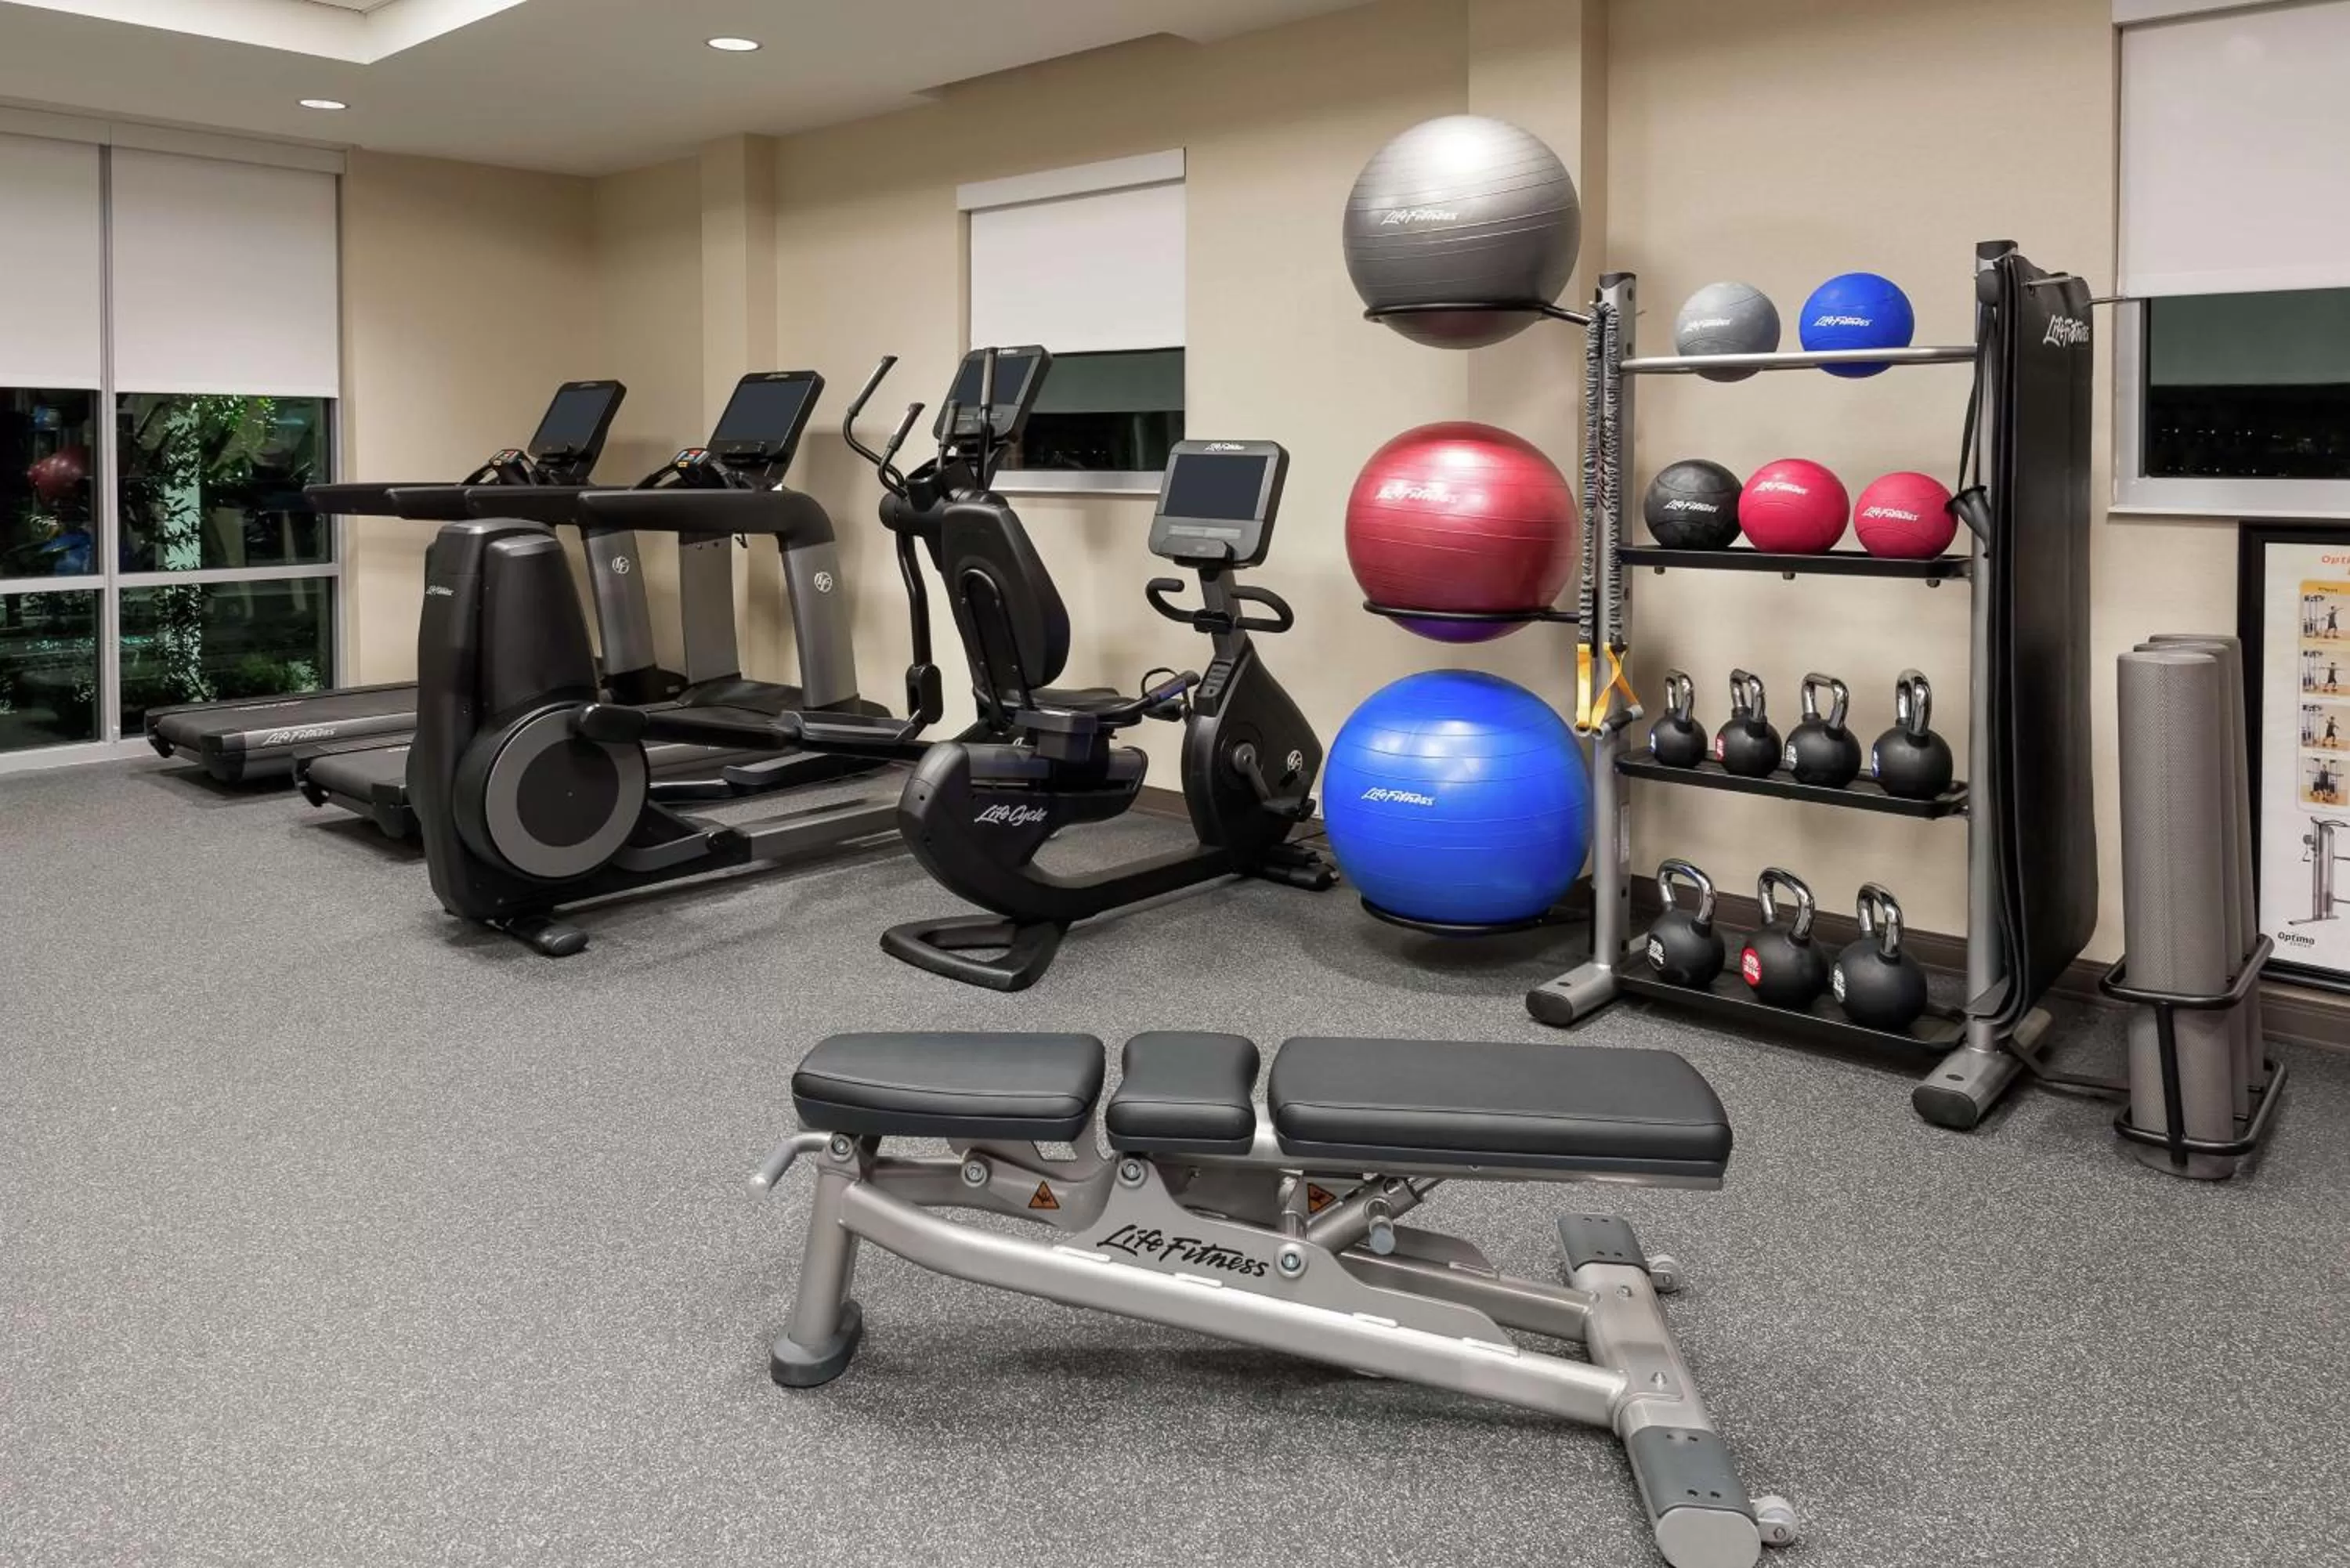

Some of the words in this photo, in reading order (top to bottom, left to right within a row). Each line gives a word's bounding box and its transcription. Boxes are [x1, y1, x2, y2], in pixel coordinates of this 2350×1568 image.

[1361, 786, 1387, 801] Life
[974, 804, 1010, 825] Life
[1096, 1223, 1165, 1257] Life
[1159, 1236, 1270, 1277] Fitness
